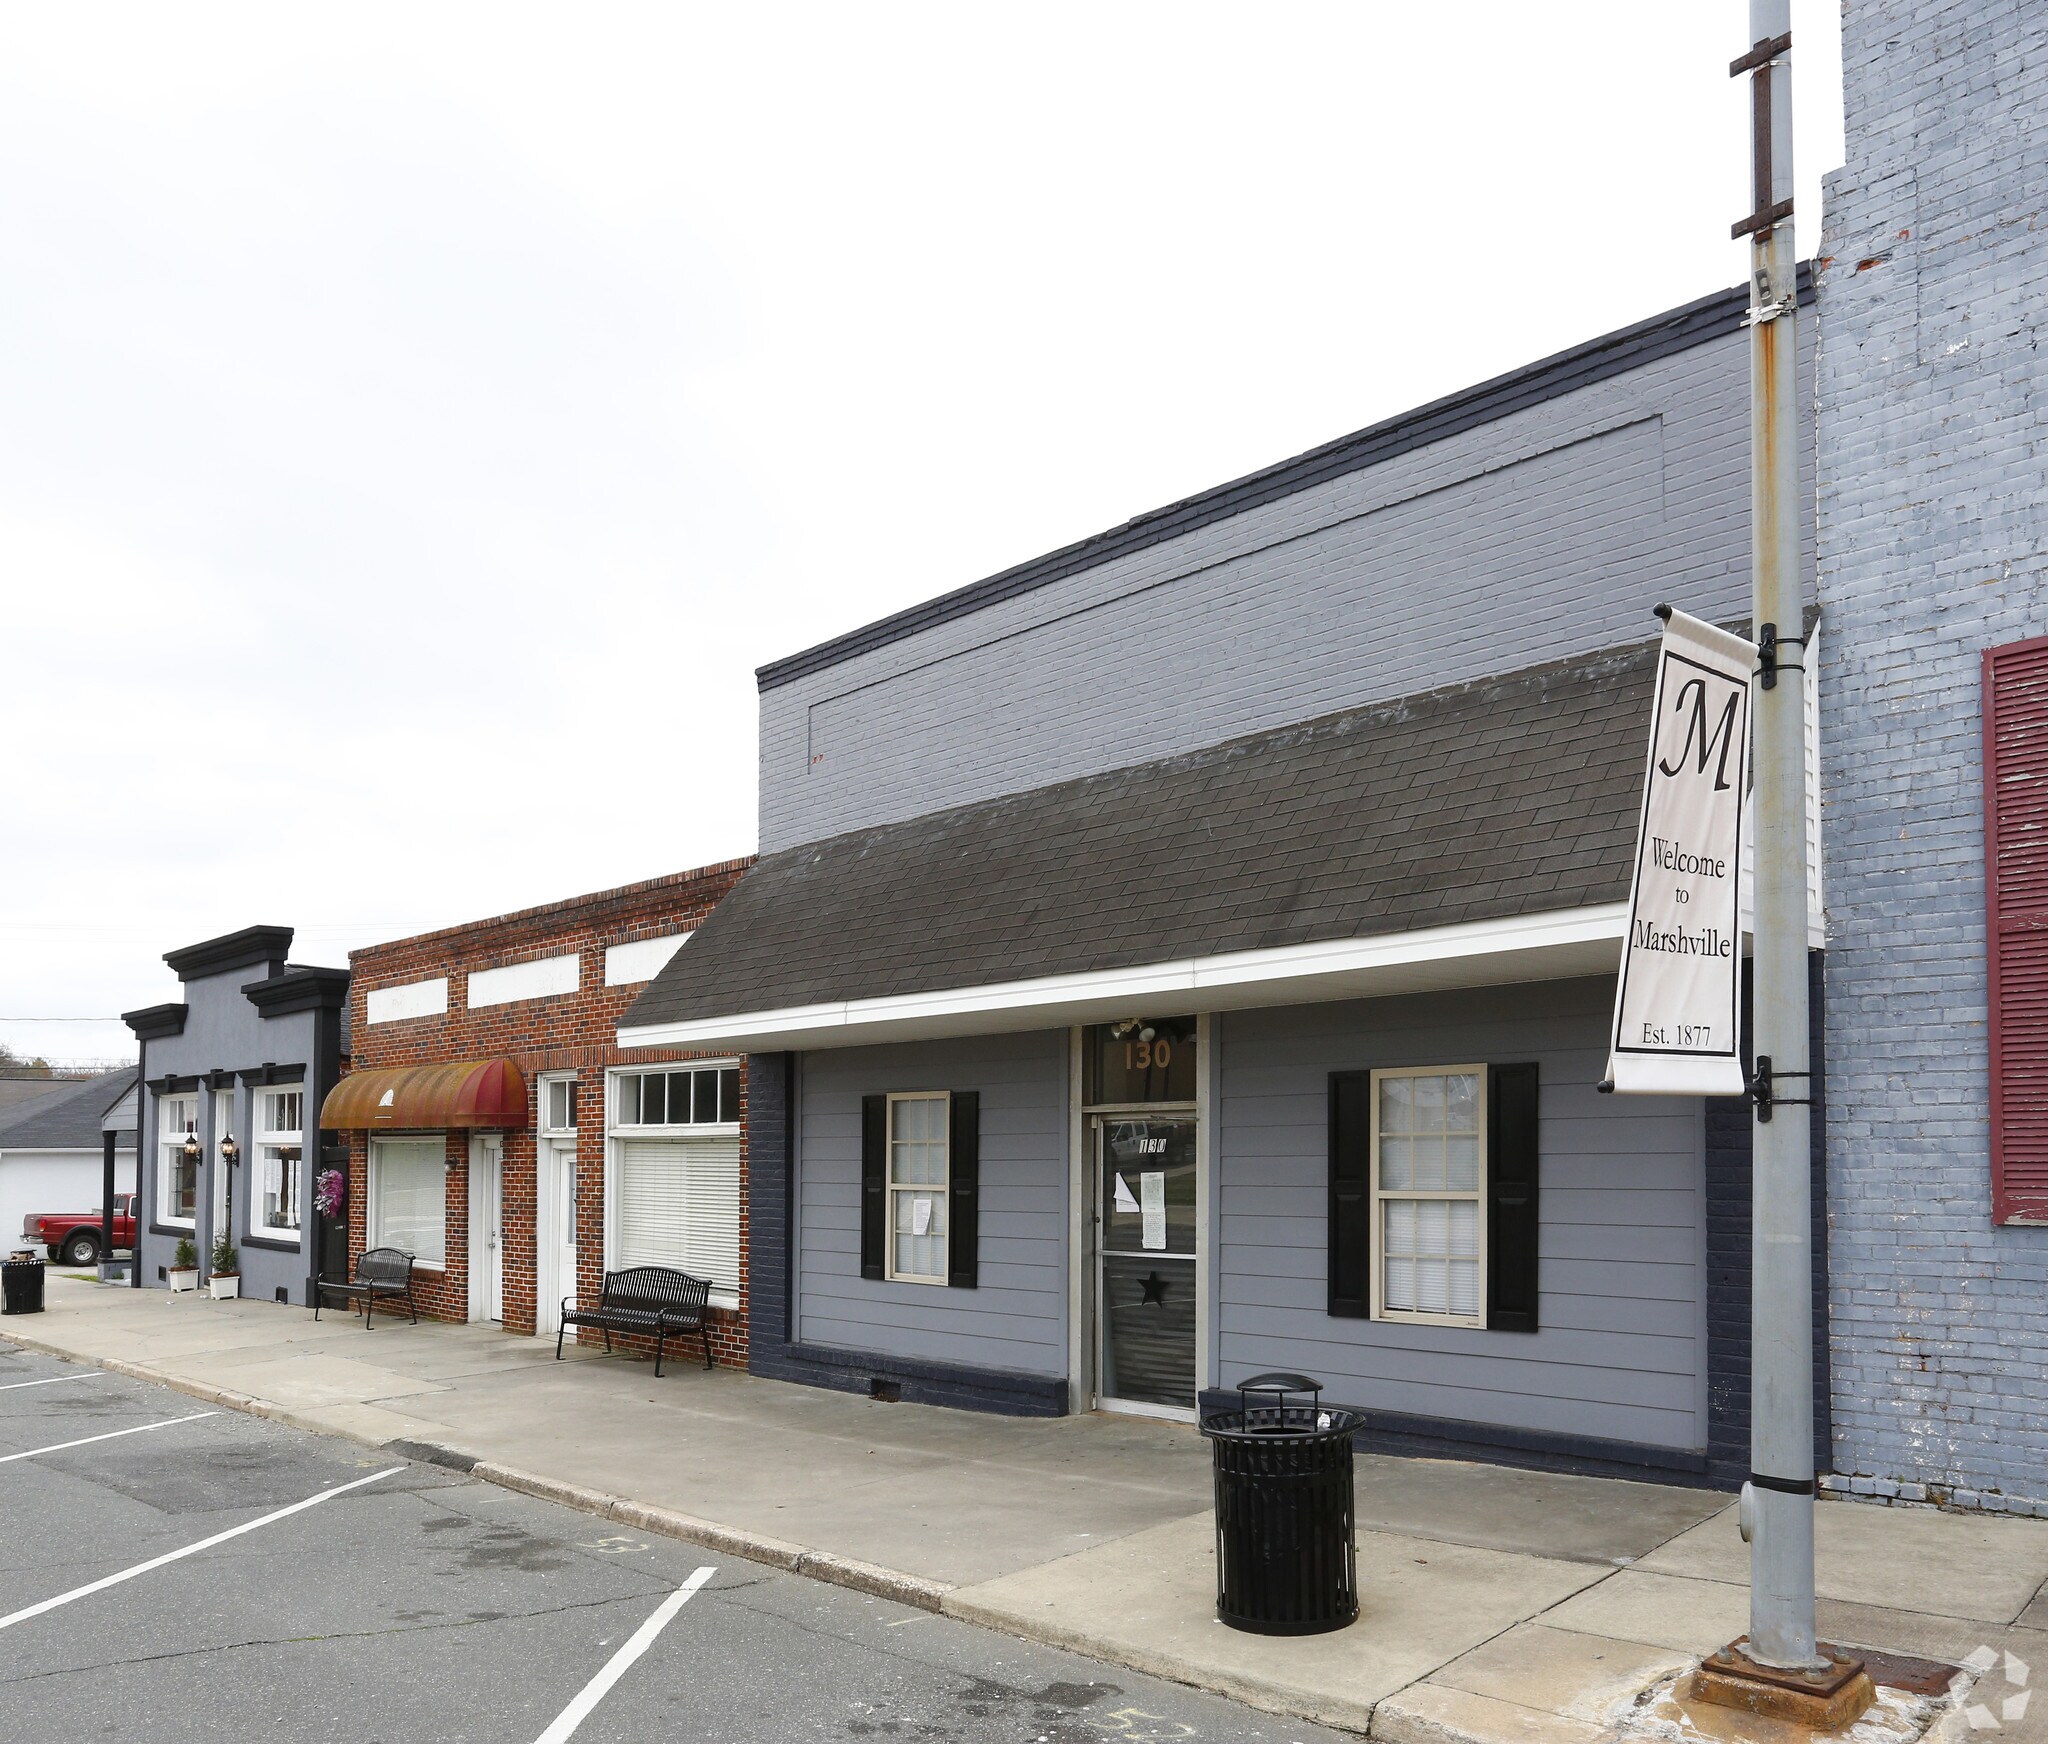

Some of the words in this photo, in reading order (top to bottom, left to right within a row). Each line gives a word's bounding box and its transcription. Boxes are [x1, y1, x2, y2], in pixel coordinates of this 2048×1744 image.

[1658, 678, 1740, 791] M
[1652, 836, 1725, 878] Welcome
[1675, 886, 1689, 904] to
[1633, 919, 1731, 958] Marshville
[1642, 1022, 1670, 1044] Est.
[1677, 1024, 1711, 1046] 1877
[1126, 1040, 1171, 1070] 130
[1139, 1138, 1167, 1154] 130
